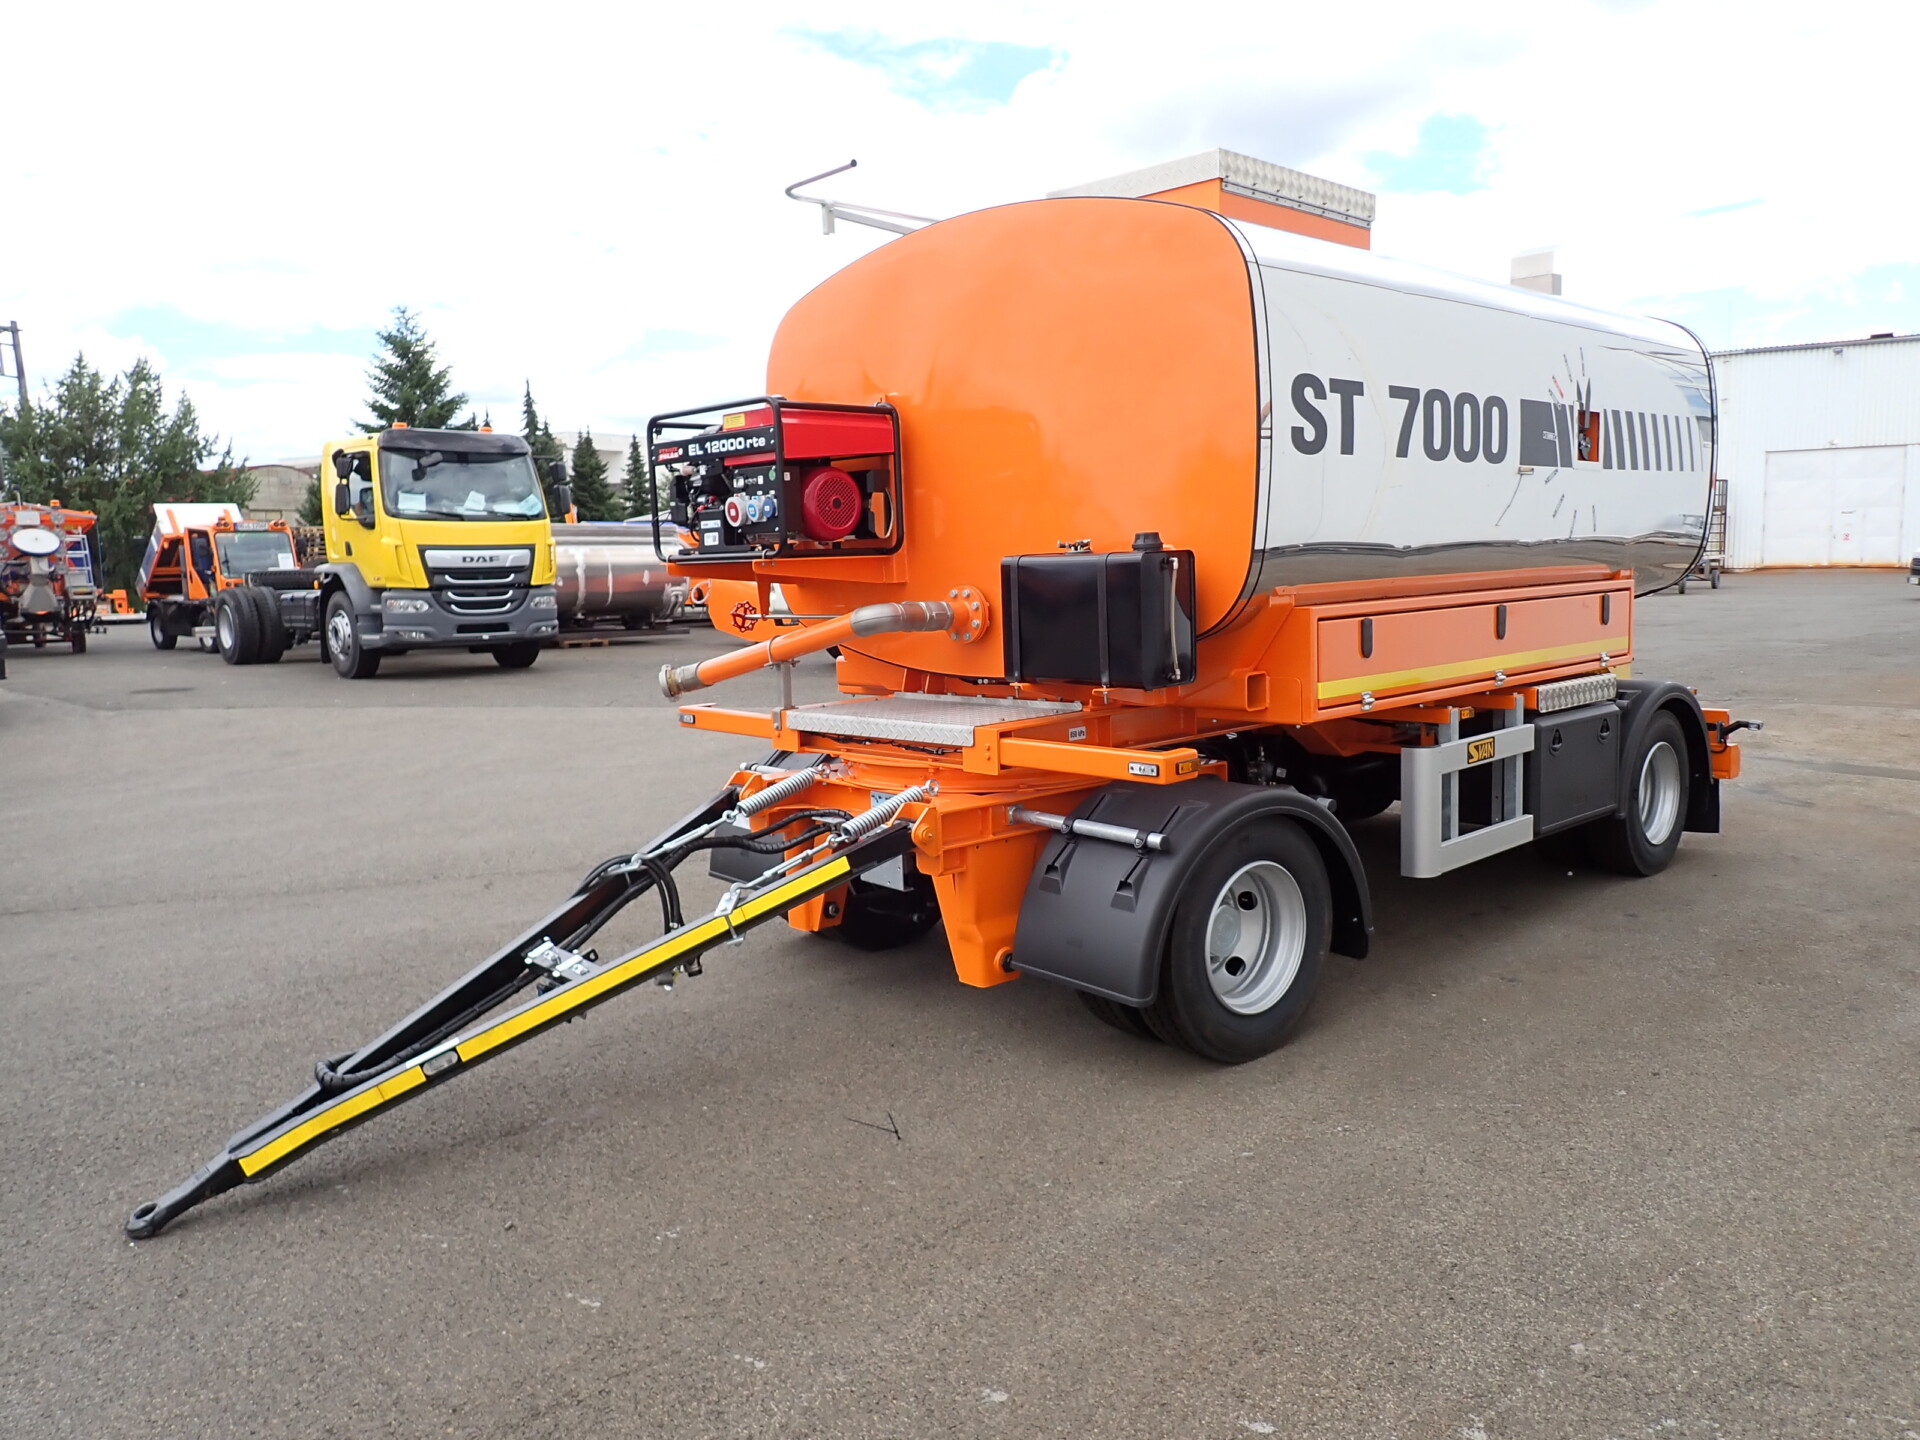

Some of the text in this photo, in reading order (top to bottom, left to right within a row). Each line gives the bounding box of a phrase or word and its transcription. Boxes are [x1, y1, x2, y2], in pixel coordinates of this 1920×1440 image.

[1291, 373, 1508, 464] ST 7000
[688, 443, 704, 456] EL
[705, 437, 744, 453] 12000
[746, 436, 766, 448] rte
[462, 555, 500, 563] DAF
